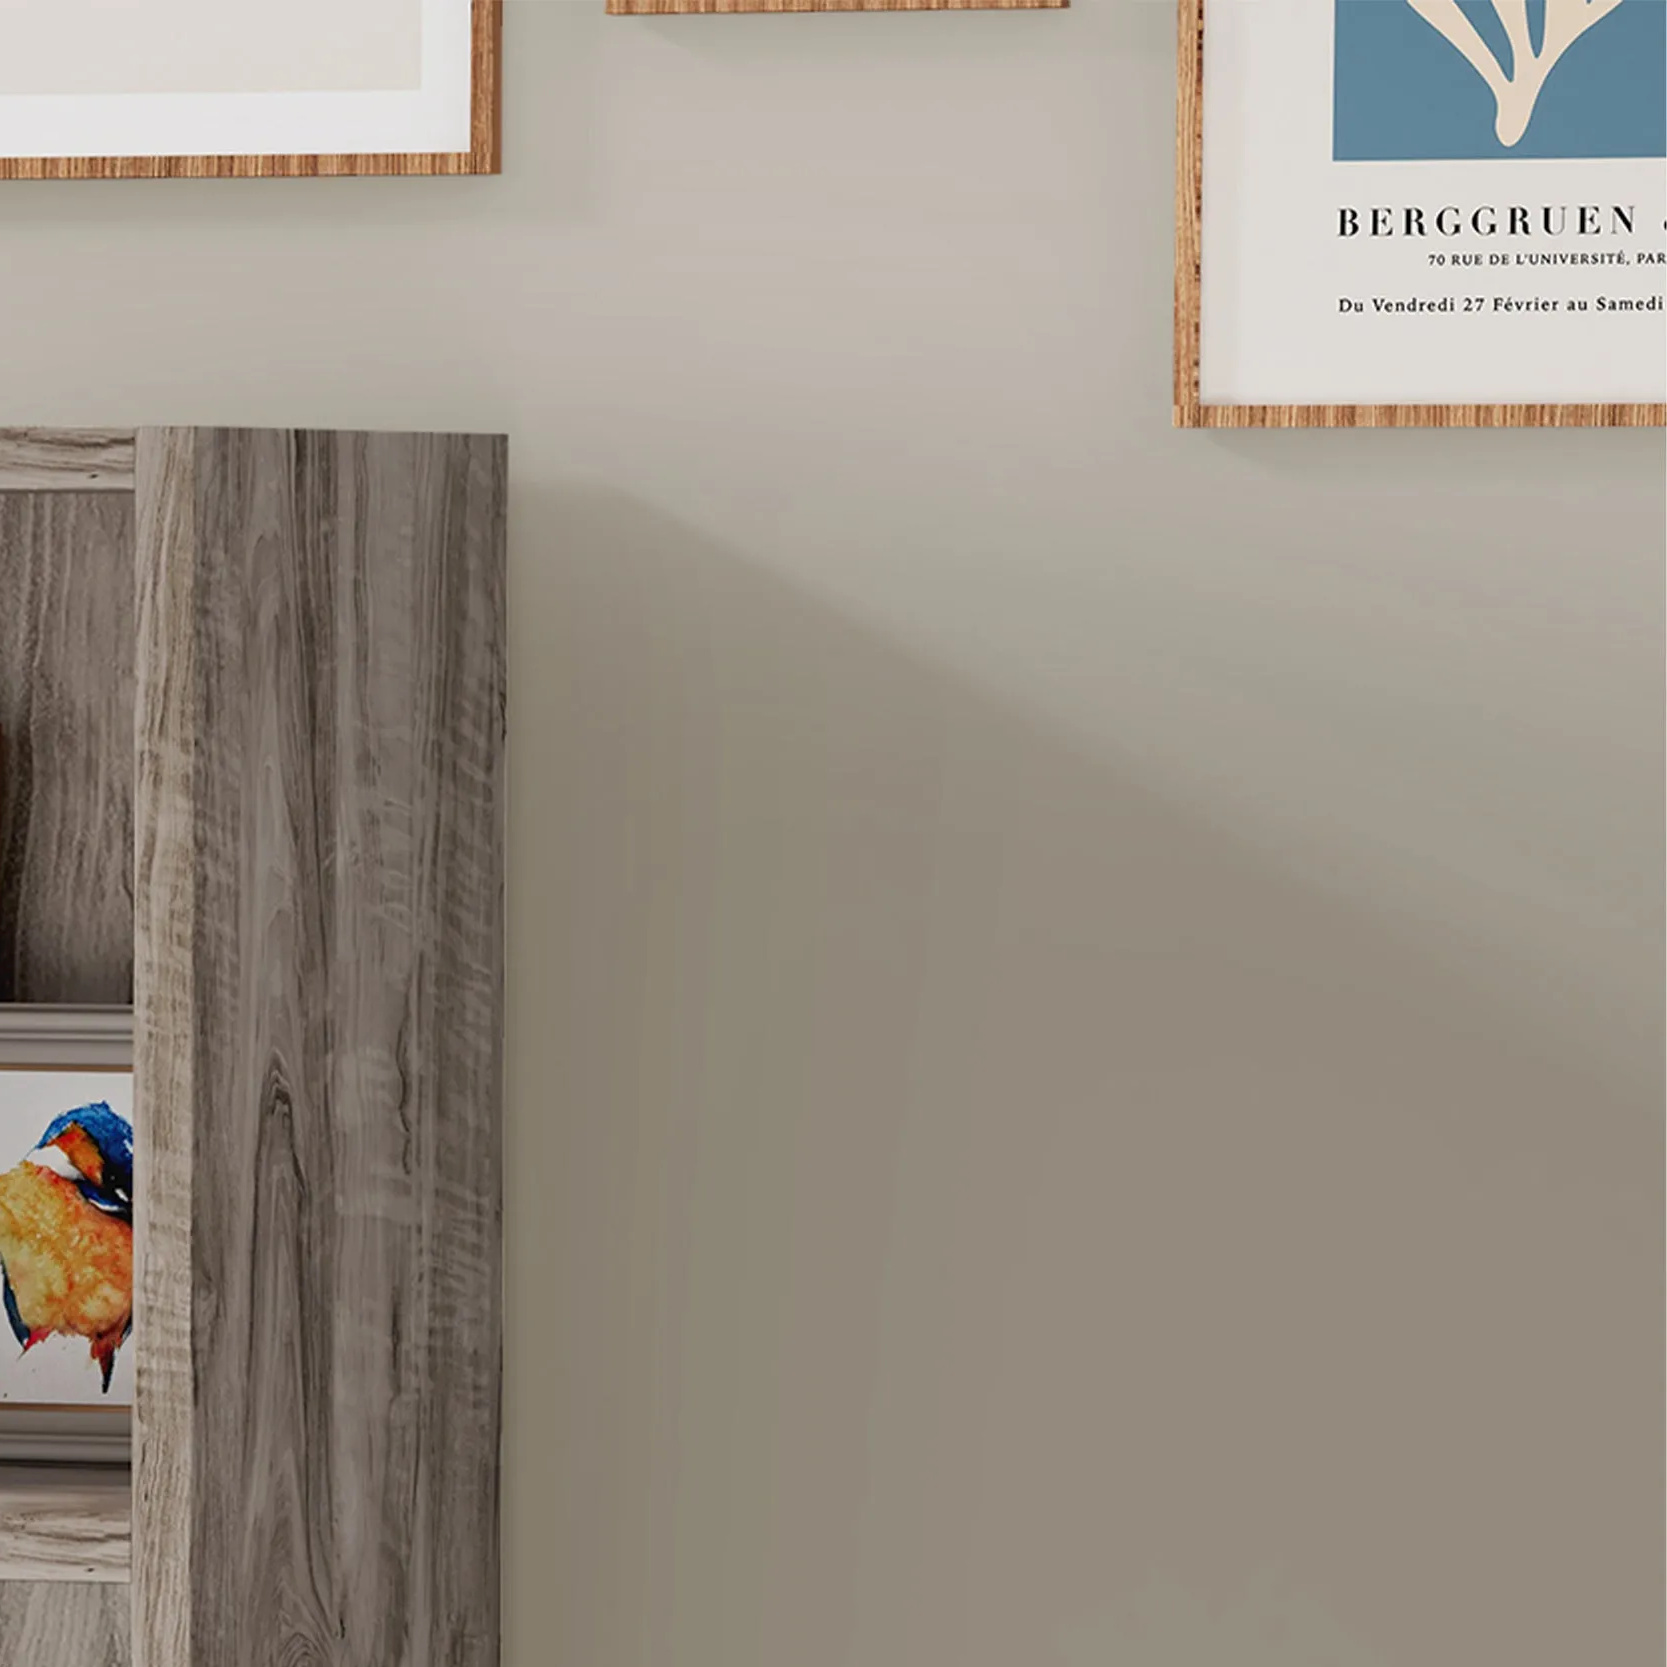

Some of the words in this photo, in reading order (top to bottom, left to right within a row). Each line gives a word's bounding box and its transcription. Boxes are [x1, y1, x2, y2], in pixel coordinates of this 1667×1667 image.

[1337, 205, 1635, 237] BERGGRUEN
[1428, 253, 1446, 267] 70
[1451, 253, 1483, 267] RUE
[1489, 253, 1510, 266] DE
[1515, 249, 1631, 267] L'UNIVERSITÉ,
[1636, 252, 1667, 265] PAR
[1338, 297, 1364, 313] Du
[1371, 296, 1455, 313] Vendredi
[1463, 296, 1485, 313] 27
[1493, 295, 1559, 313] Février
[1566, 300, 1588, 312] au
[1595, 295, 1664, 312] Samedi
